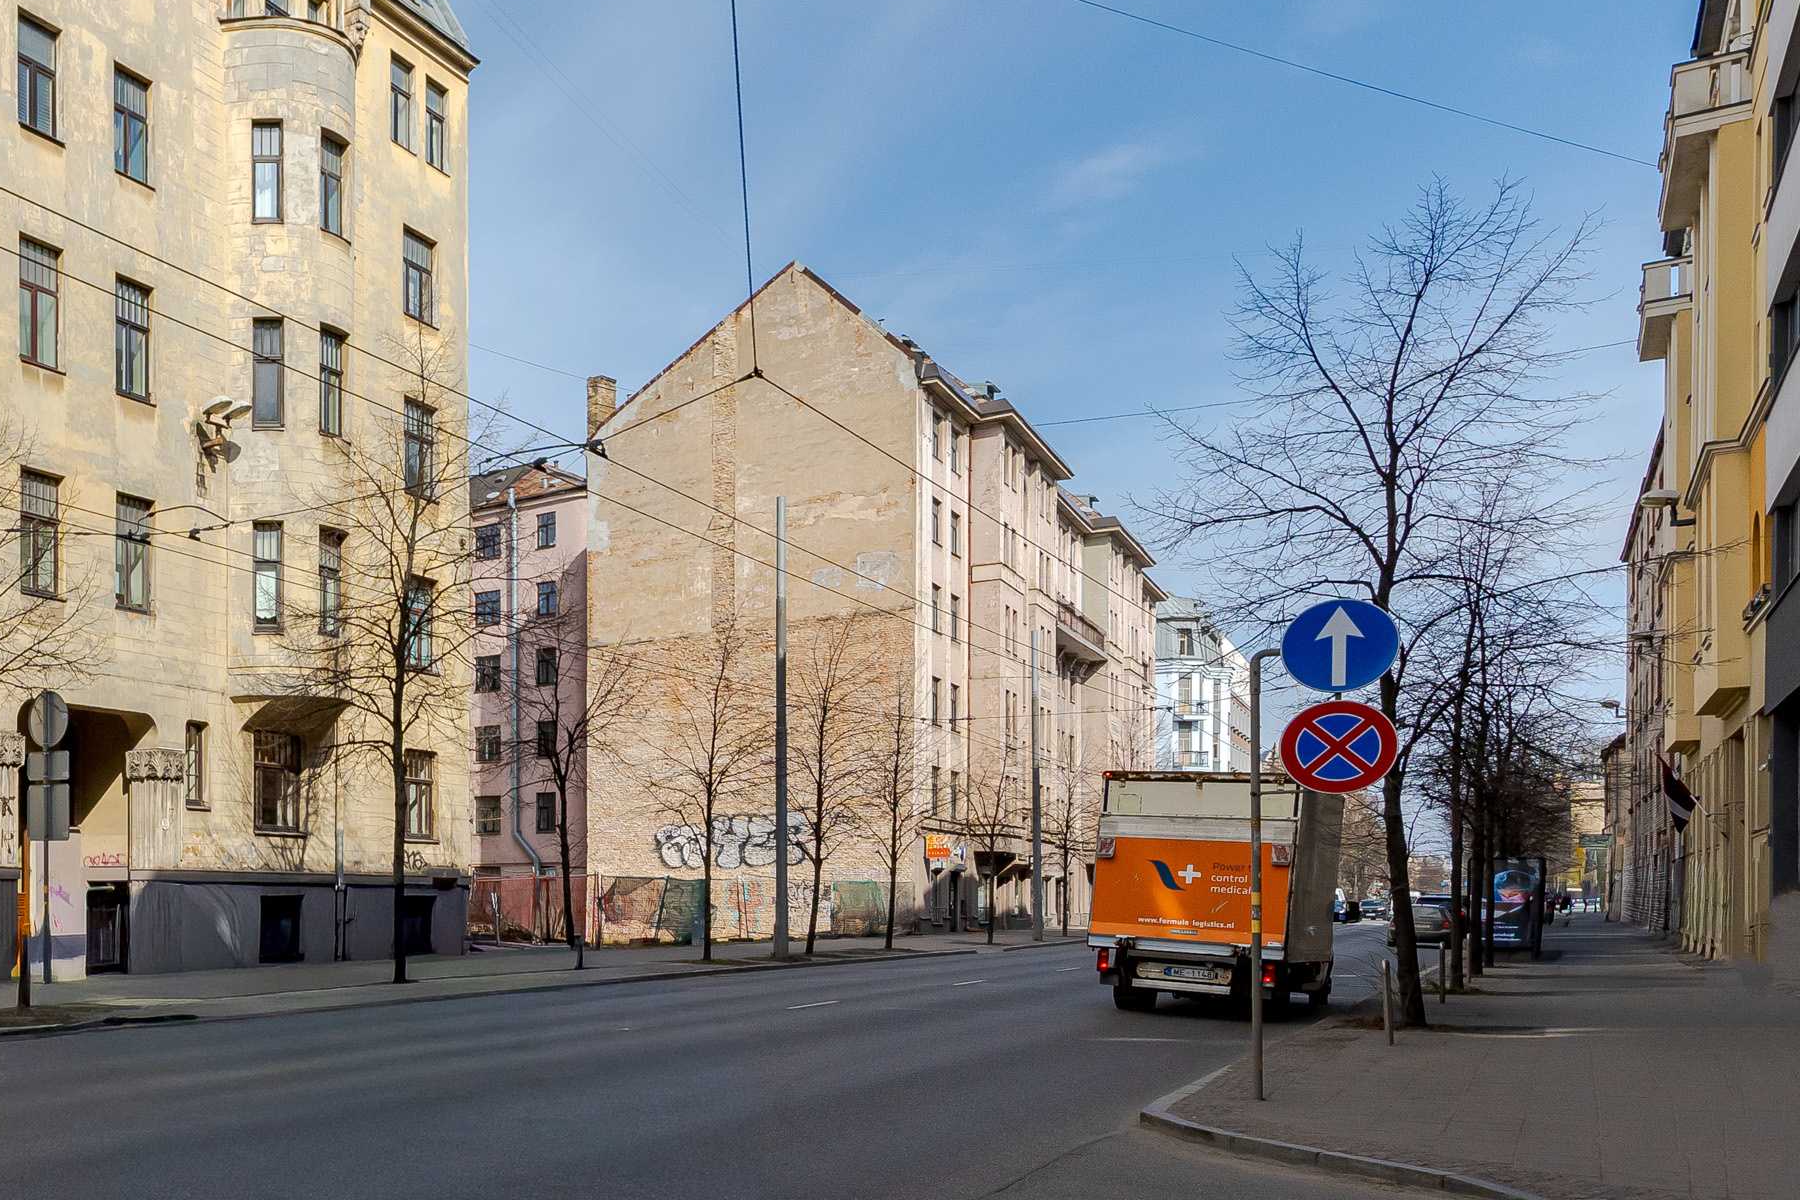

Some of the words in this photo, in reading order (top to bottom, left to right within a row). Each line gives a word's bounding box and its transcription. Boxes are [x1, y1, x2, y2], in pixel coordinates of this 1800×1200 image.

[1213, 862, 1245, 871] Power
[1211, 874, 1248, 883] control
[1210, 885, 1252, 895] medical
